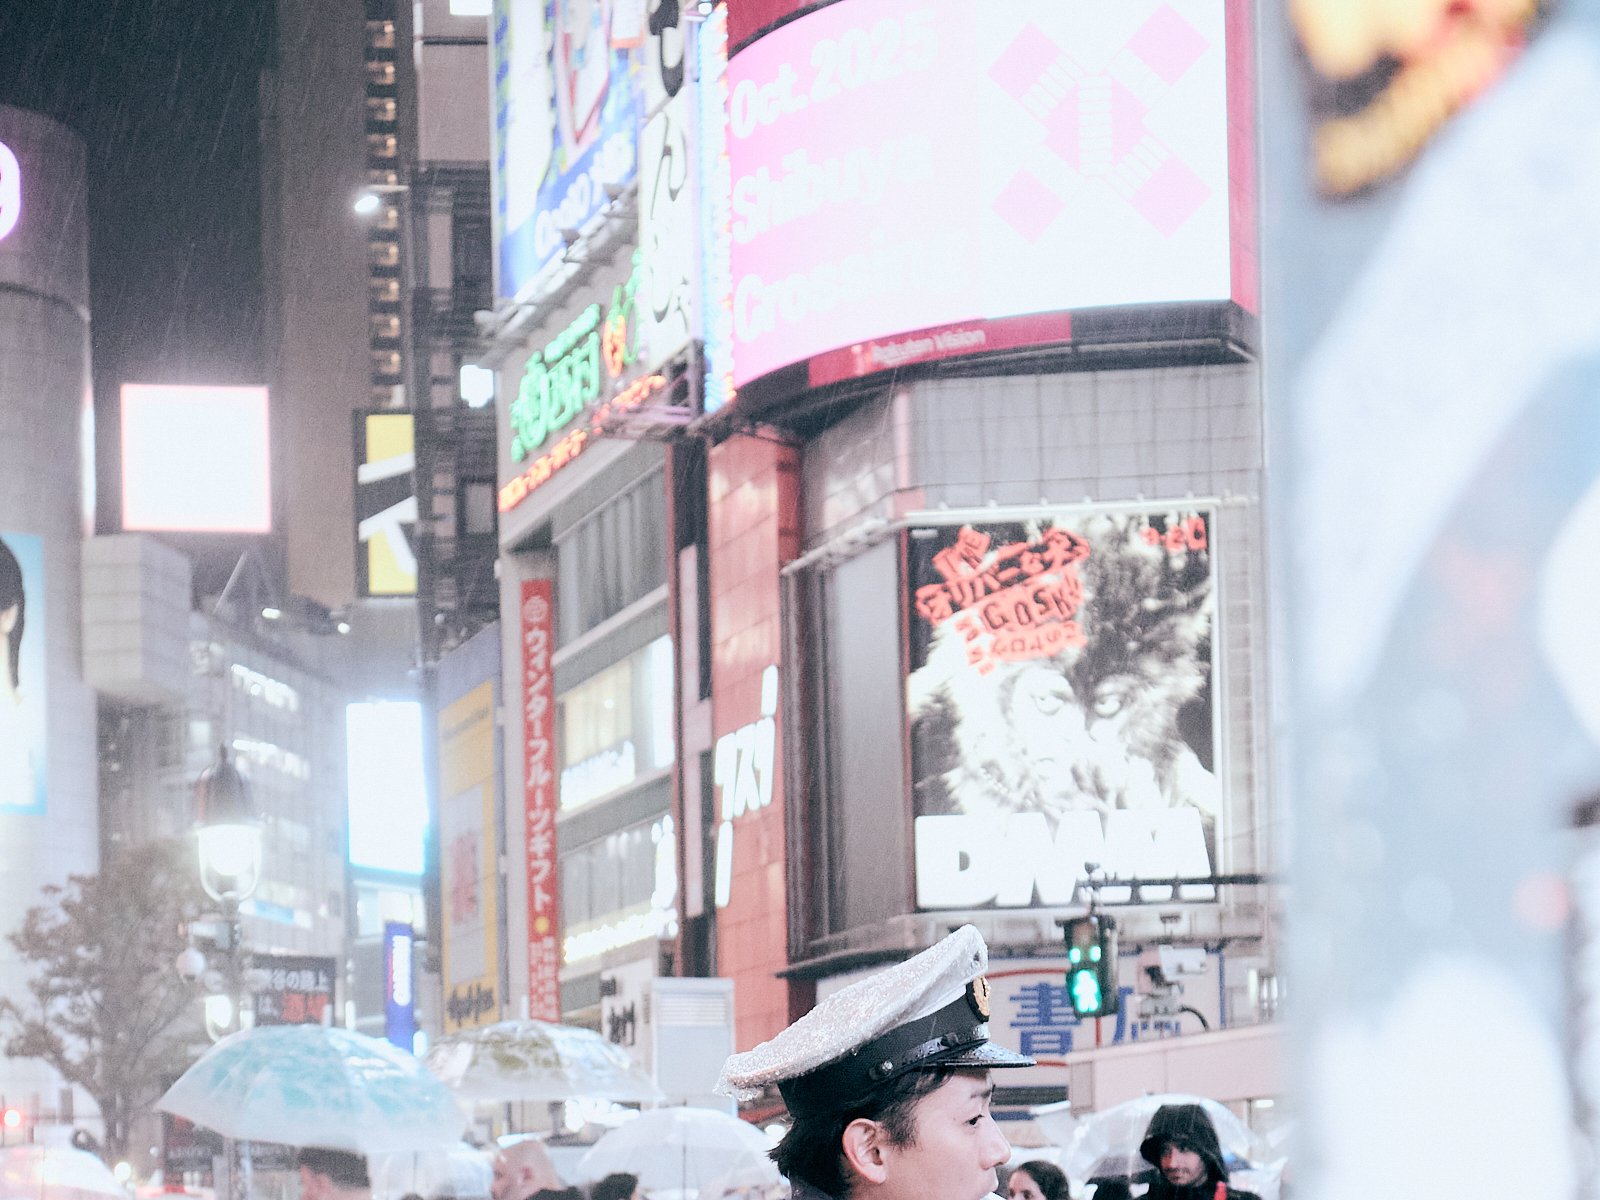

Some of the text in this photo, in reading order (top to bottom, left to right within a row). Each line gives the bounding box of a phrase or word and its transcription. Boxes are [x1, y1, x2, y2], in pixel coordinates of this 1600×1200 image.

[731, 8, 940, 139] Oct.2025
[731, 132, 936, 245] Shibuya
[525, 626, 552, 912] ウィンターフルーツギフト
